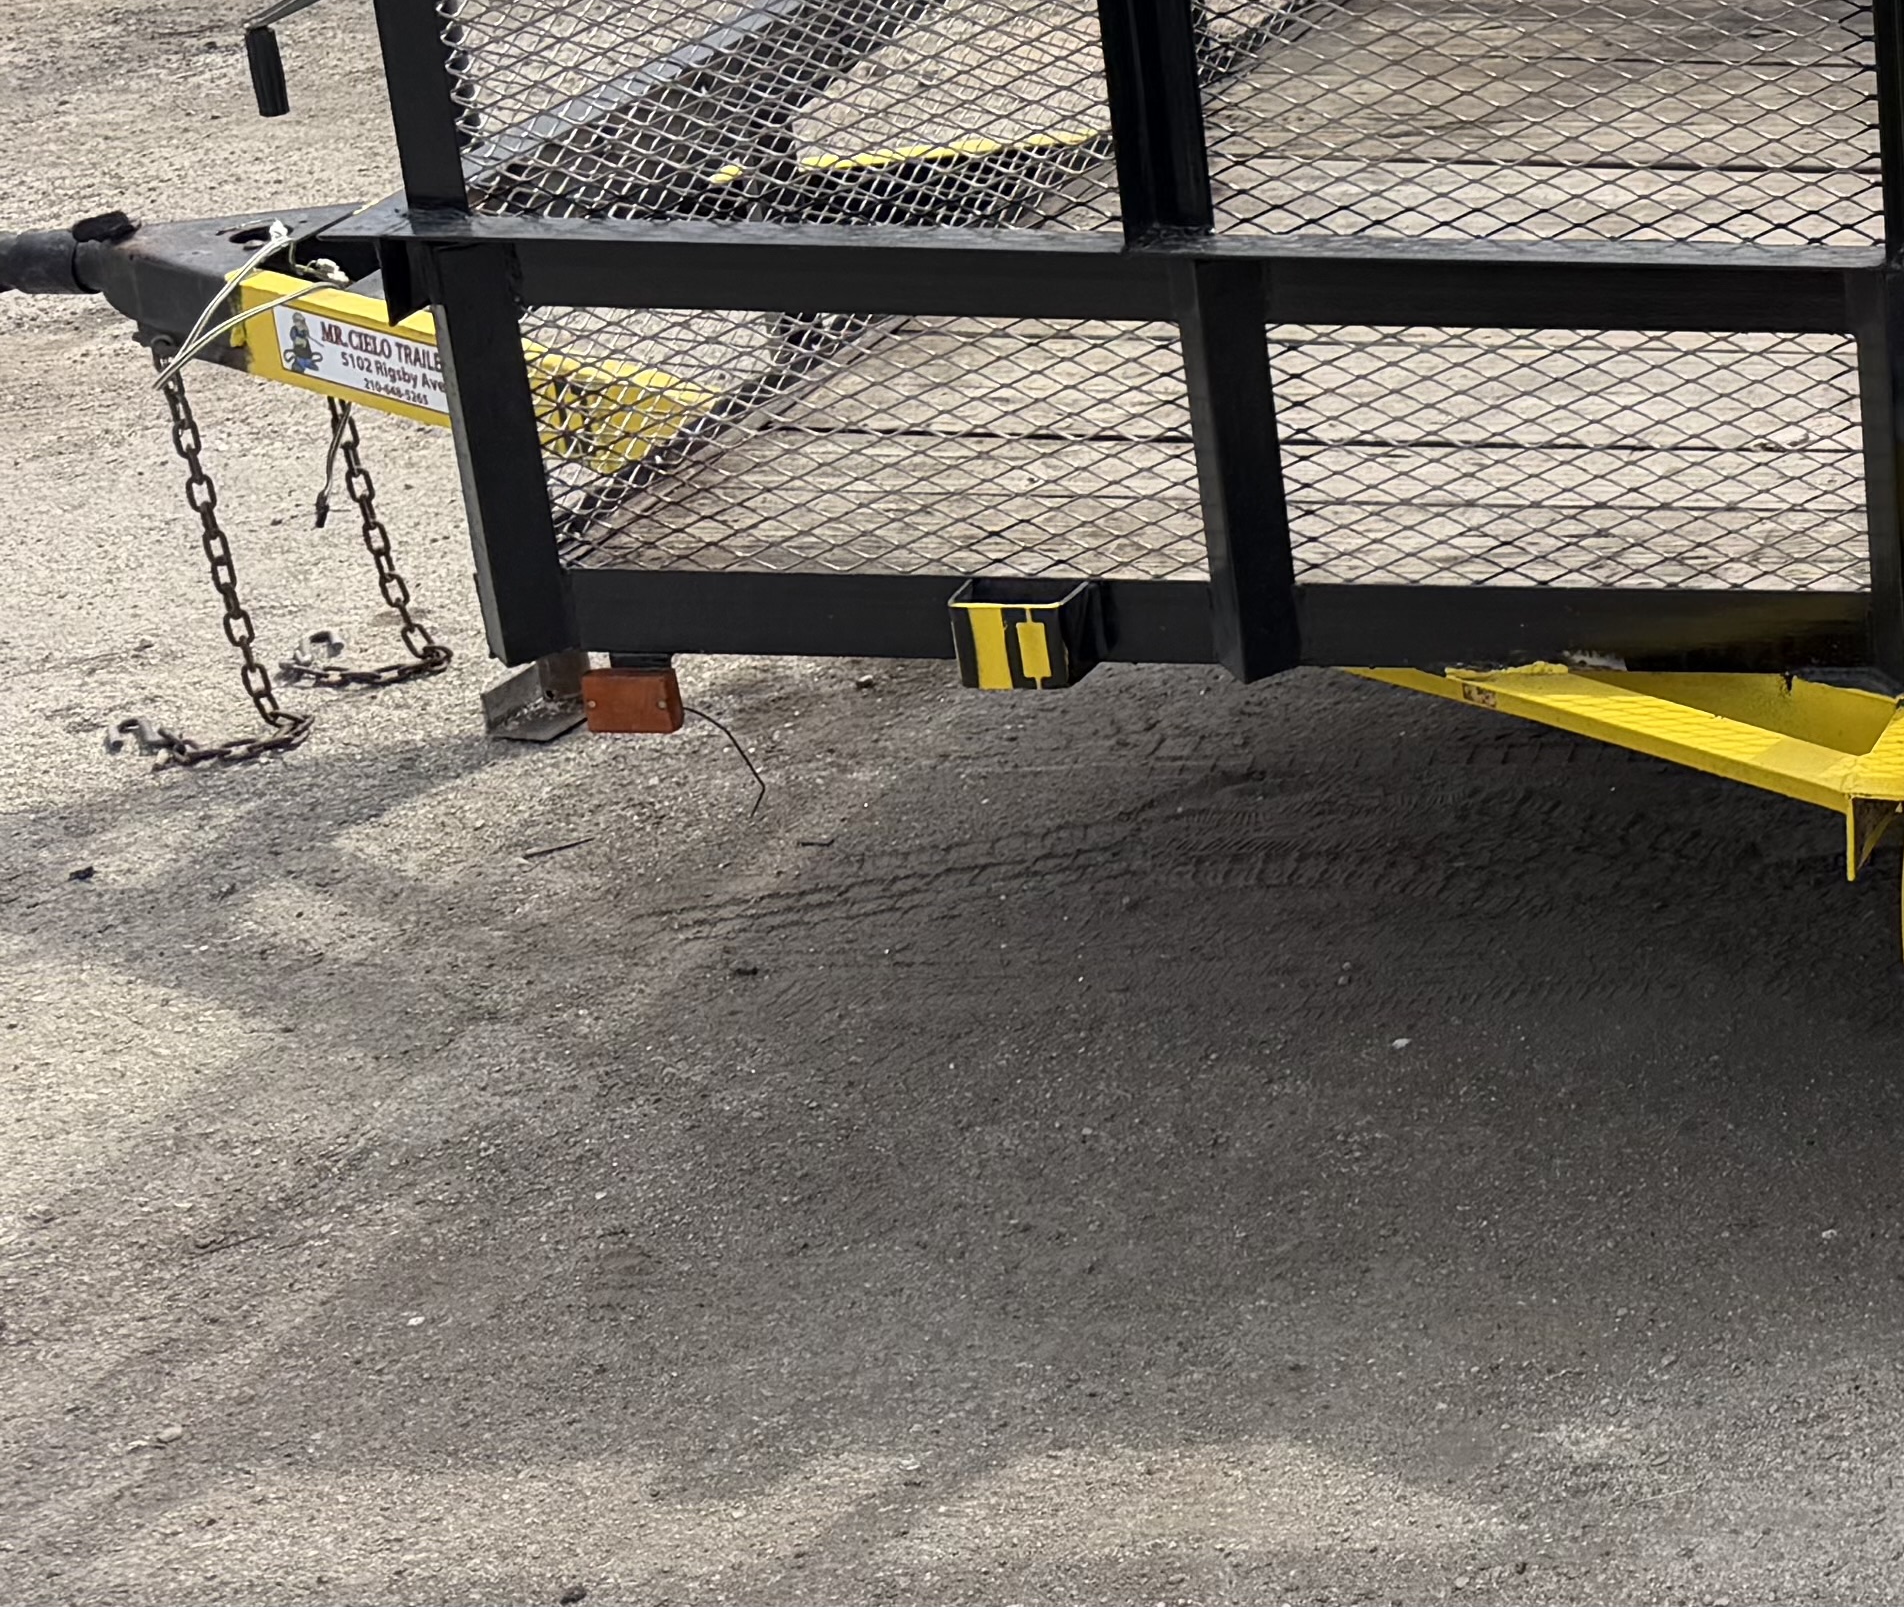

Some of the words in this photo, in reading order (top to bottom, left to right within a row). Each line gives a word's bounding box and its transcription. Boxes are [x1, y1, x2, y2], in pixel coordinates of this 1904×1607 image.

[320, 321, 348, 348] MR.
[348, 329, 392, 360] CIELO
[341, 351, 373, 373] 5102
[375, 360, 418, 389] Rigsby
